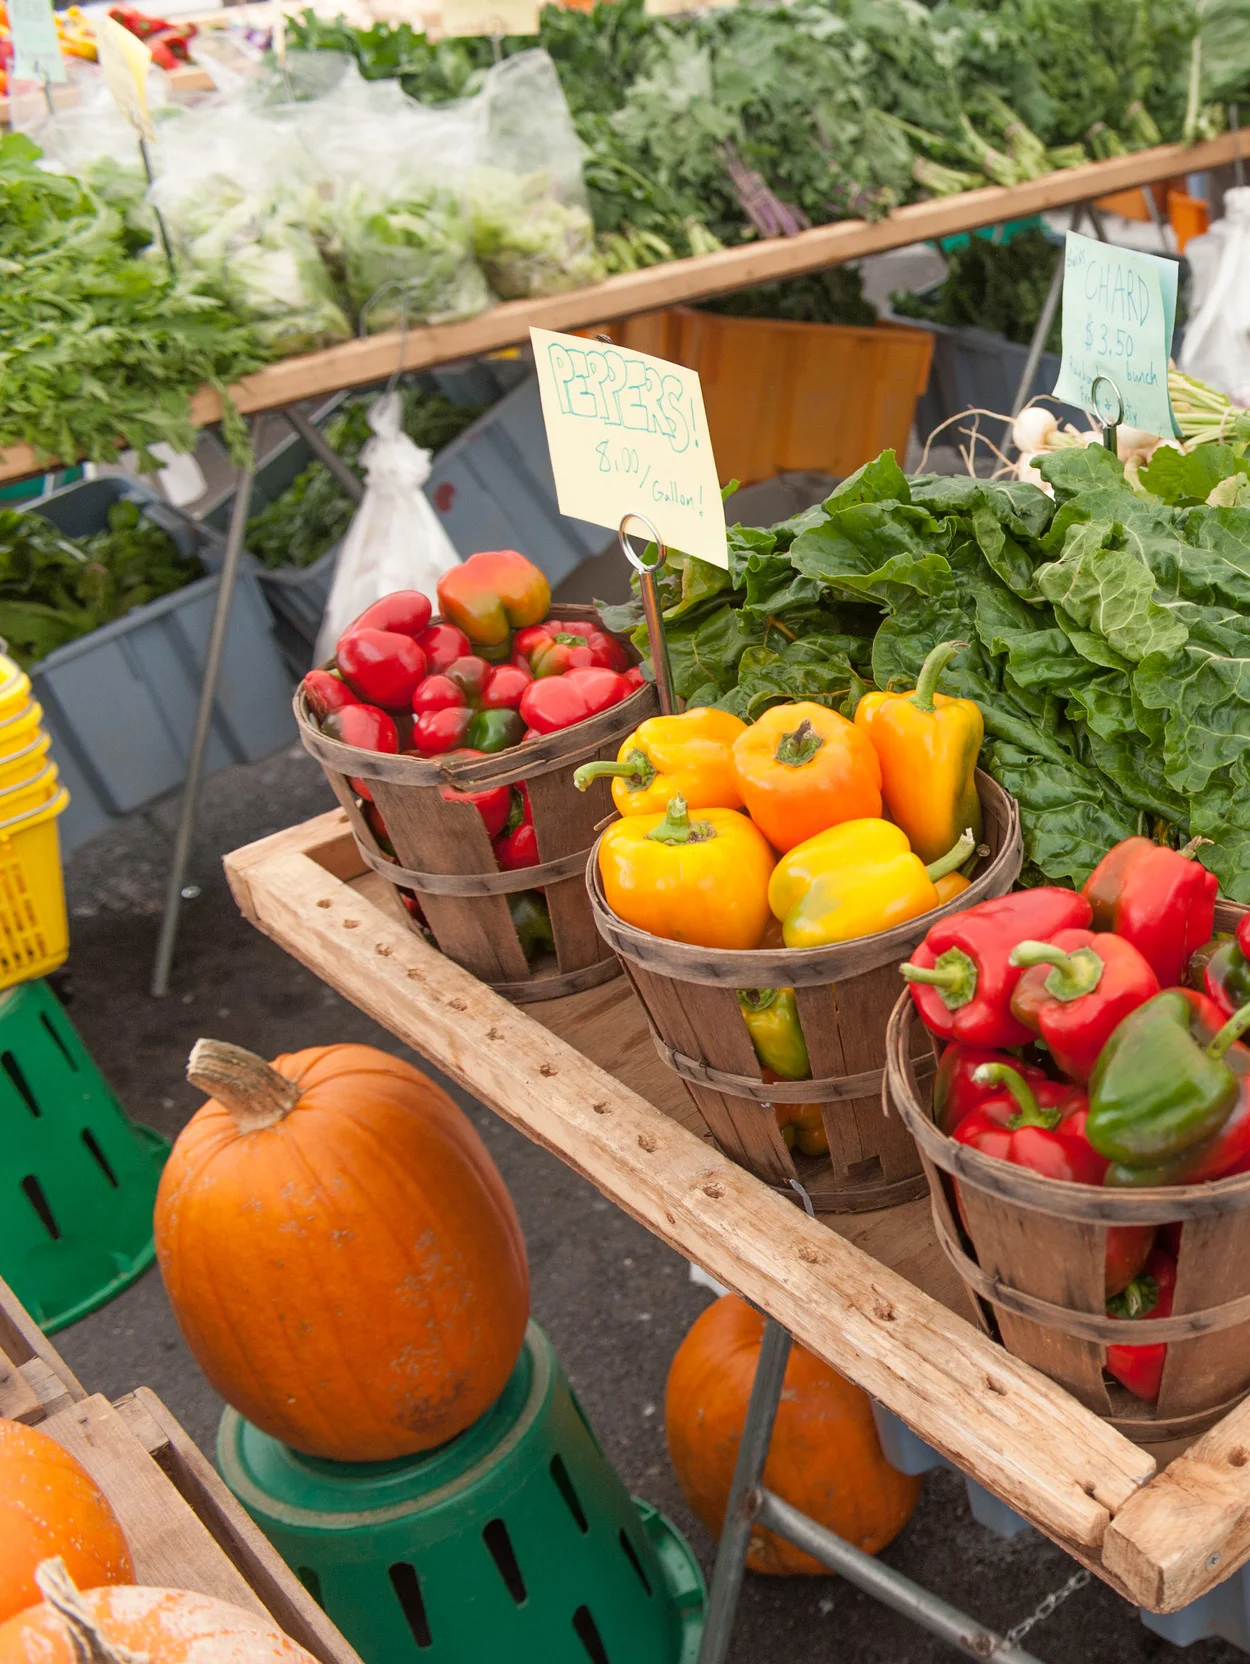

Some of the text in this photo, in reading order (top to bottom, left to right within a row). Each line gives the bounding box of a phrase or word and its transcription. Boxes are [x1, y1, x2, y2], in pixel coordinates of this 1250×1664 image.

[1084, 260, 1150, 327] CHARD
[1084, 315, 1134, 357] $3.50
[547, 342, 700, 454] PEPPERS!
[1126, 360, 1159, 386] bunch
